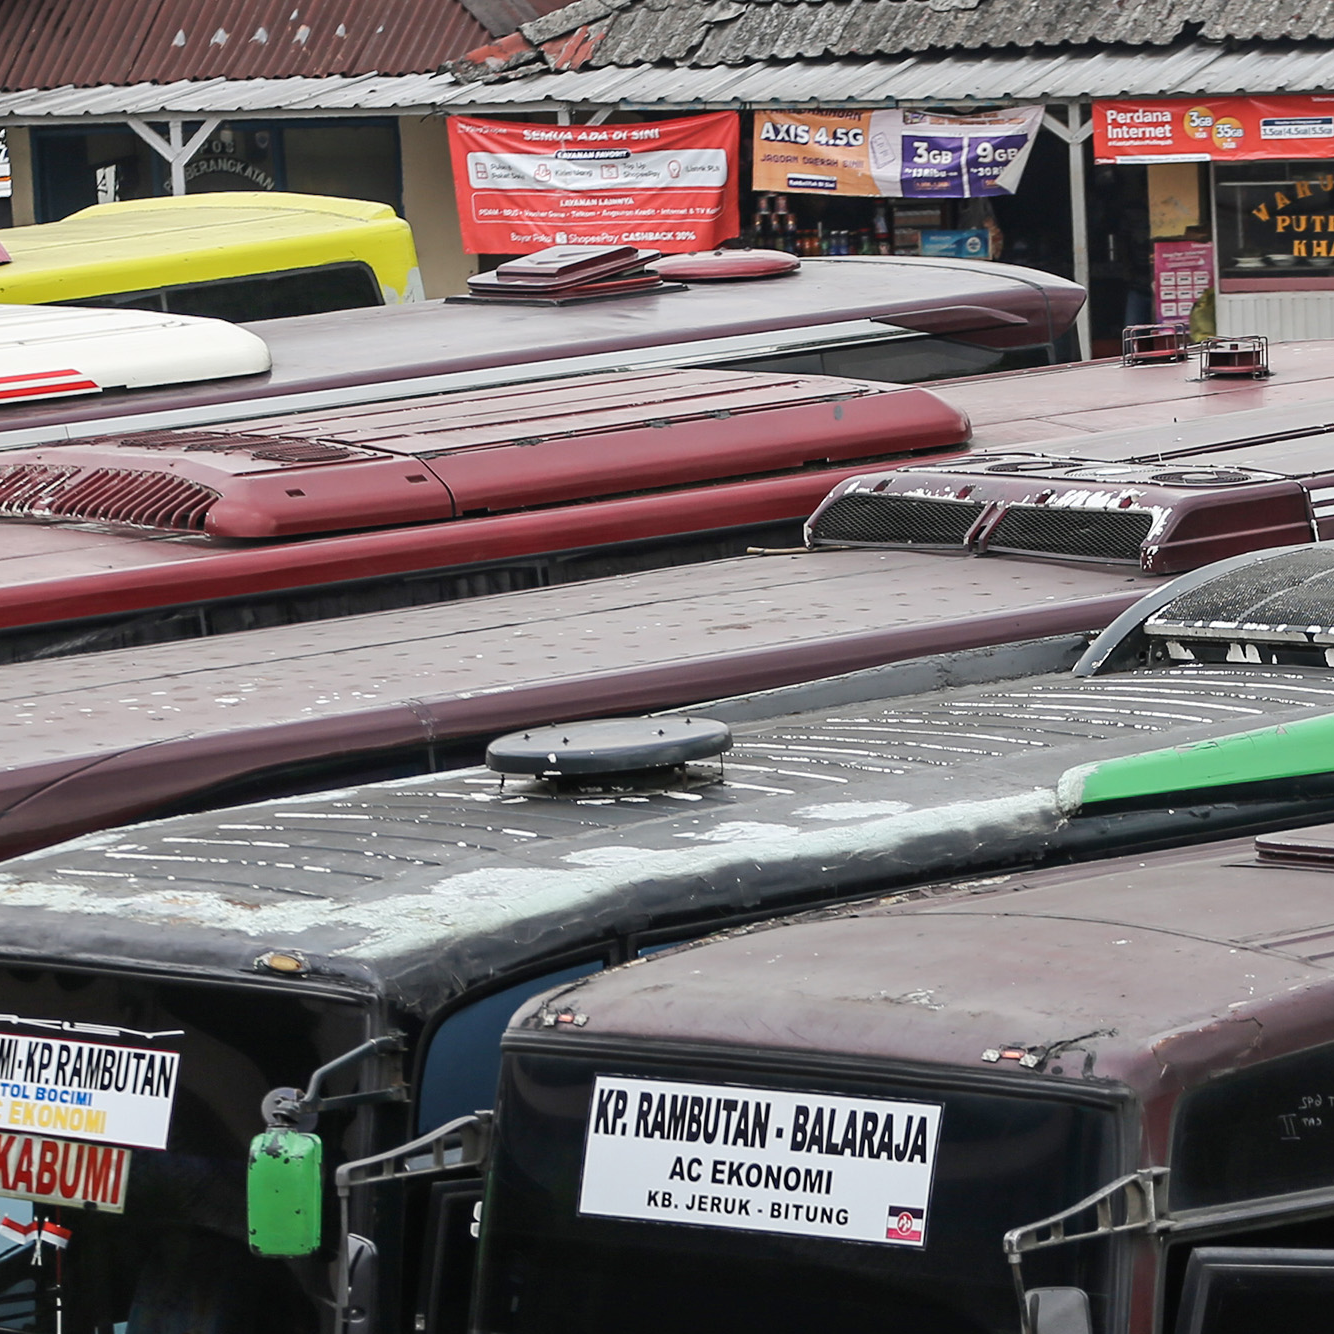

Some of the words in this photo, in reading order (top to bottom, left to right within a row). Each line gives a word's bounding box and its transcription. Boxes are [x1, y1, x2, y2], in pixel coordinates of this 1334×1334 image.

[1106, 109, 1172, 124] Perdana
[1189, 111, 1213, 128] 3GB
[523, 129, 573, 141] SEMUA
[577, 130, 608, 141] ADA
[612, 130, 628, 140] DI
[760, 121, 810, 145] AXIS
[814, 126, 865, 147] 4.5G
[1107, 124, 1172, 139] Internet
[912, 141, 953, 165] 3GB
[621, 231, 674, 242] CASHBACK
[55, 1044, 176, 1099] RAMBUTAN
[0, 1083, 31, 1100] TOL
[34, 1087, 93, 1107] BOCIMI
[8, 1100, 108, 1134] EKONOMI
[593, 1087, 628, 1137] KP.
[634, 1091, 771, 1149] RAMBUTAN
[789, 1104, 928, 1164] BALARAJA
[668, 1156, 703, 1183] AC
[710, 1159, 834, 1196] EKONOMI
[646, 1189, 679, 1211] KB.
[686, 1193, 752, 1217] JERUK
[769, 1202, 851, 1226] BITUNG
